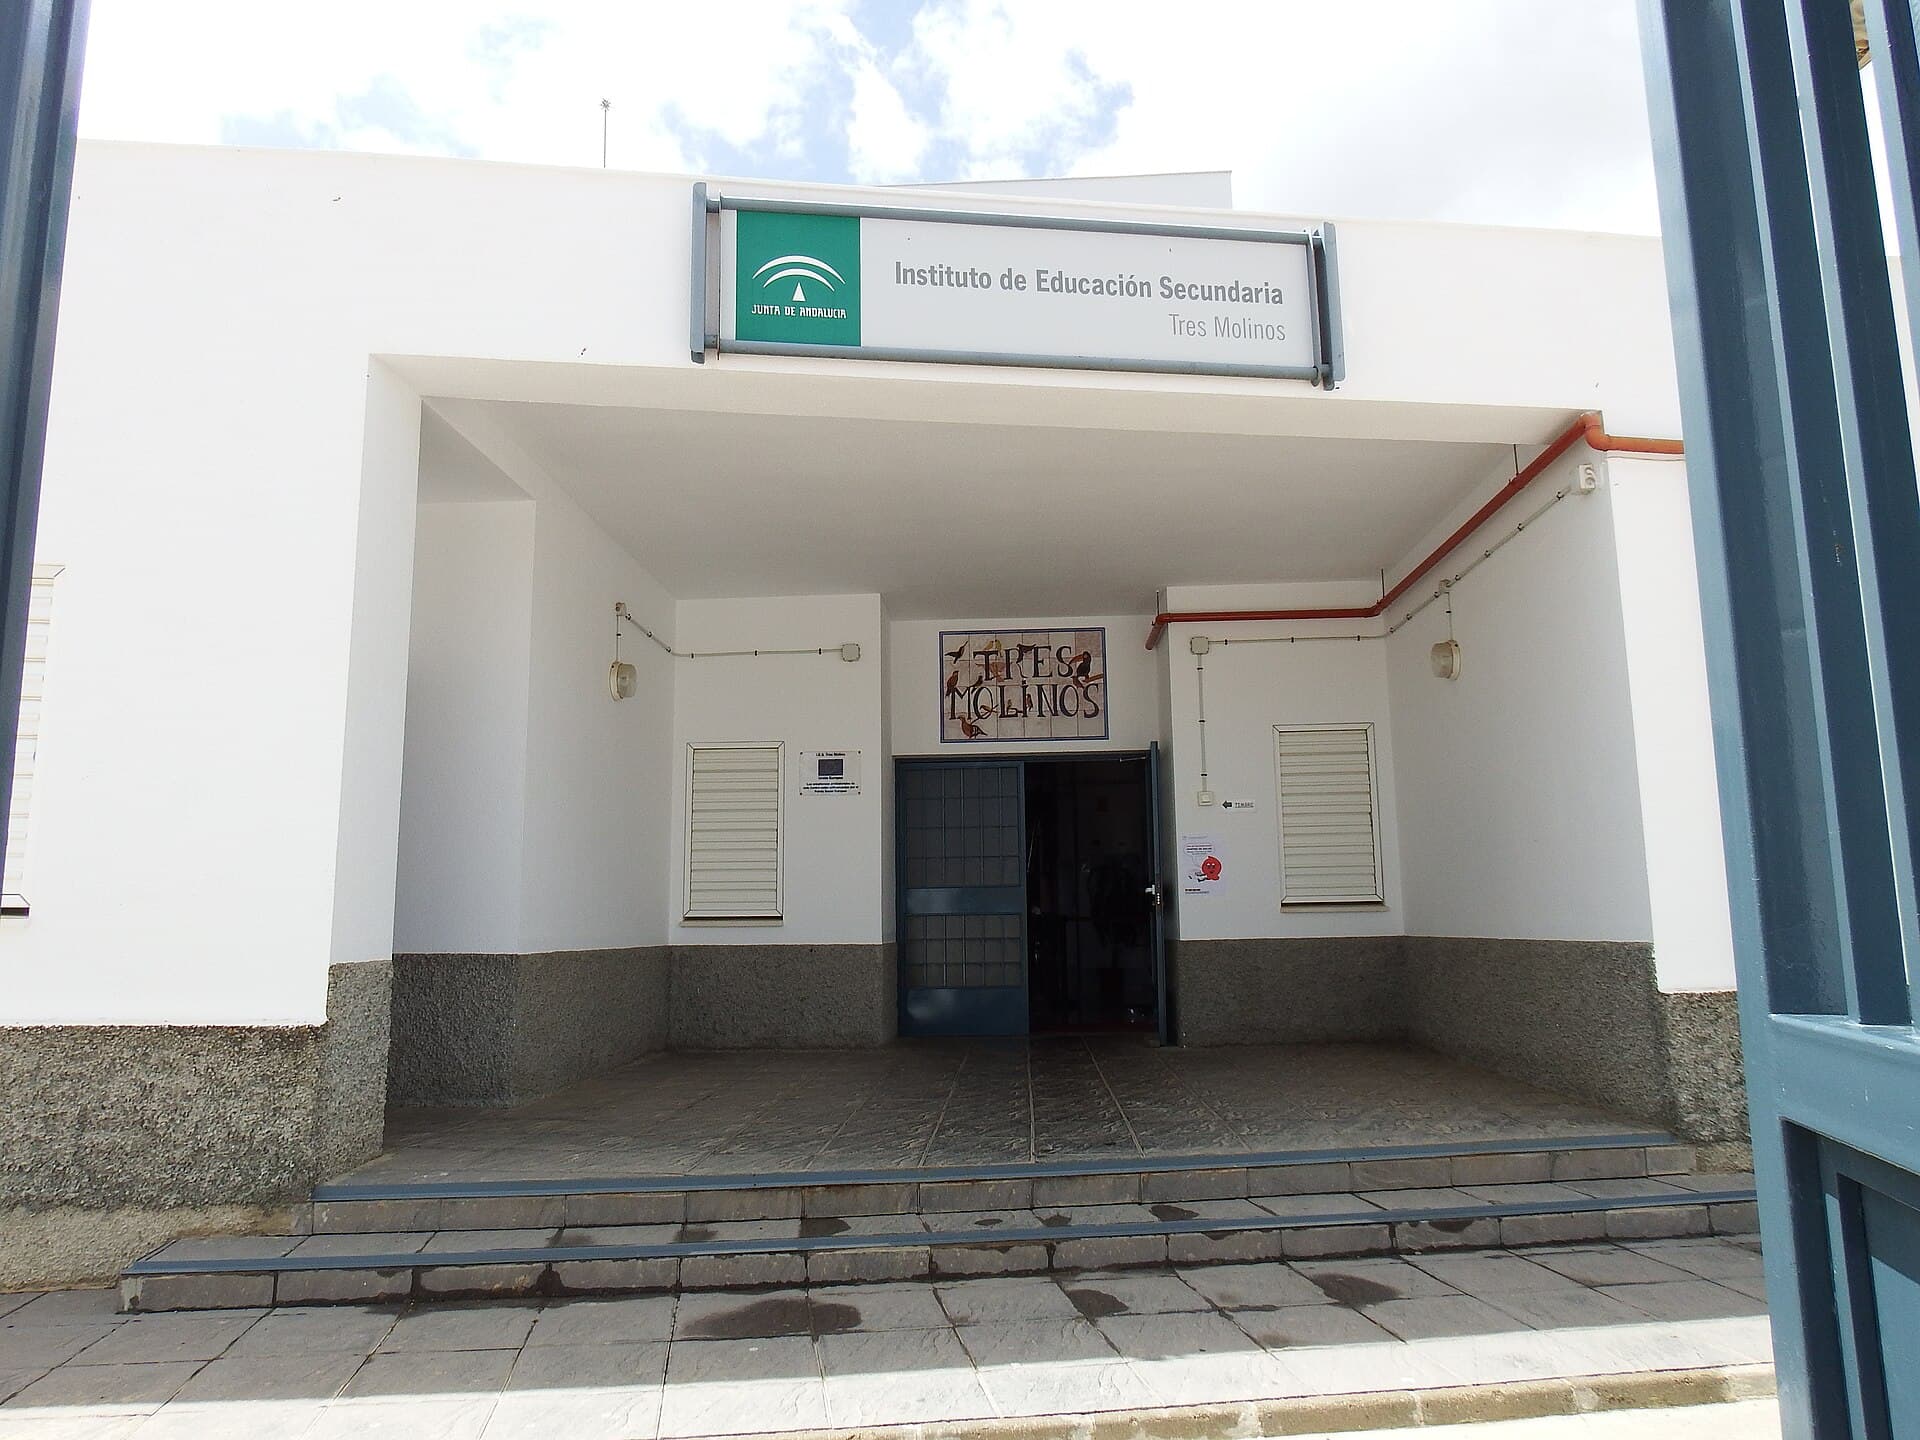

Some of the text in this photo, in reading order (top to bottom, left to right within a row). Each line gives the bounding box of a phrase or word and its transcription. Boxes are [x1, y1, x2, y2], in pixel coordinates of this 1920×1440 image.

[895, 261, 1283, 305] Instituto de Educación Secundaria
[752, 304, 780, 316] JUNTA
[784, 305, 796, 317] DE
[1168, 313, 1286, 341] Tres Molinos
[973, 645, 1074, 682] TRES
[949, 680, 1100, 720] MOLINOS
